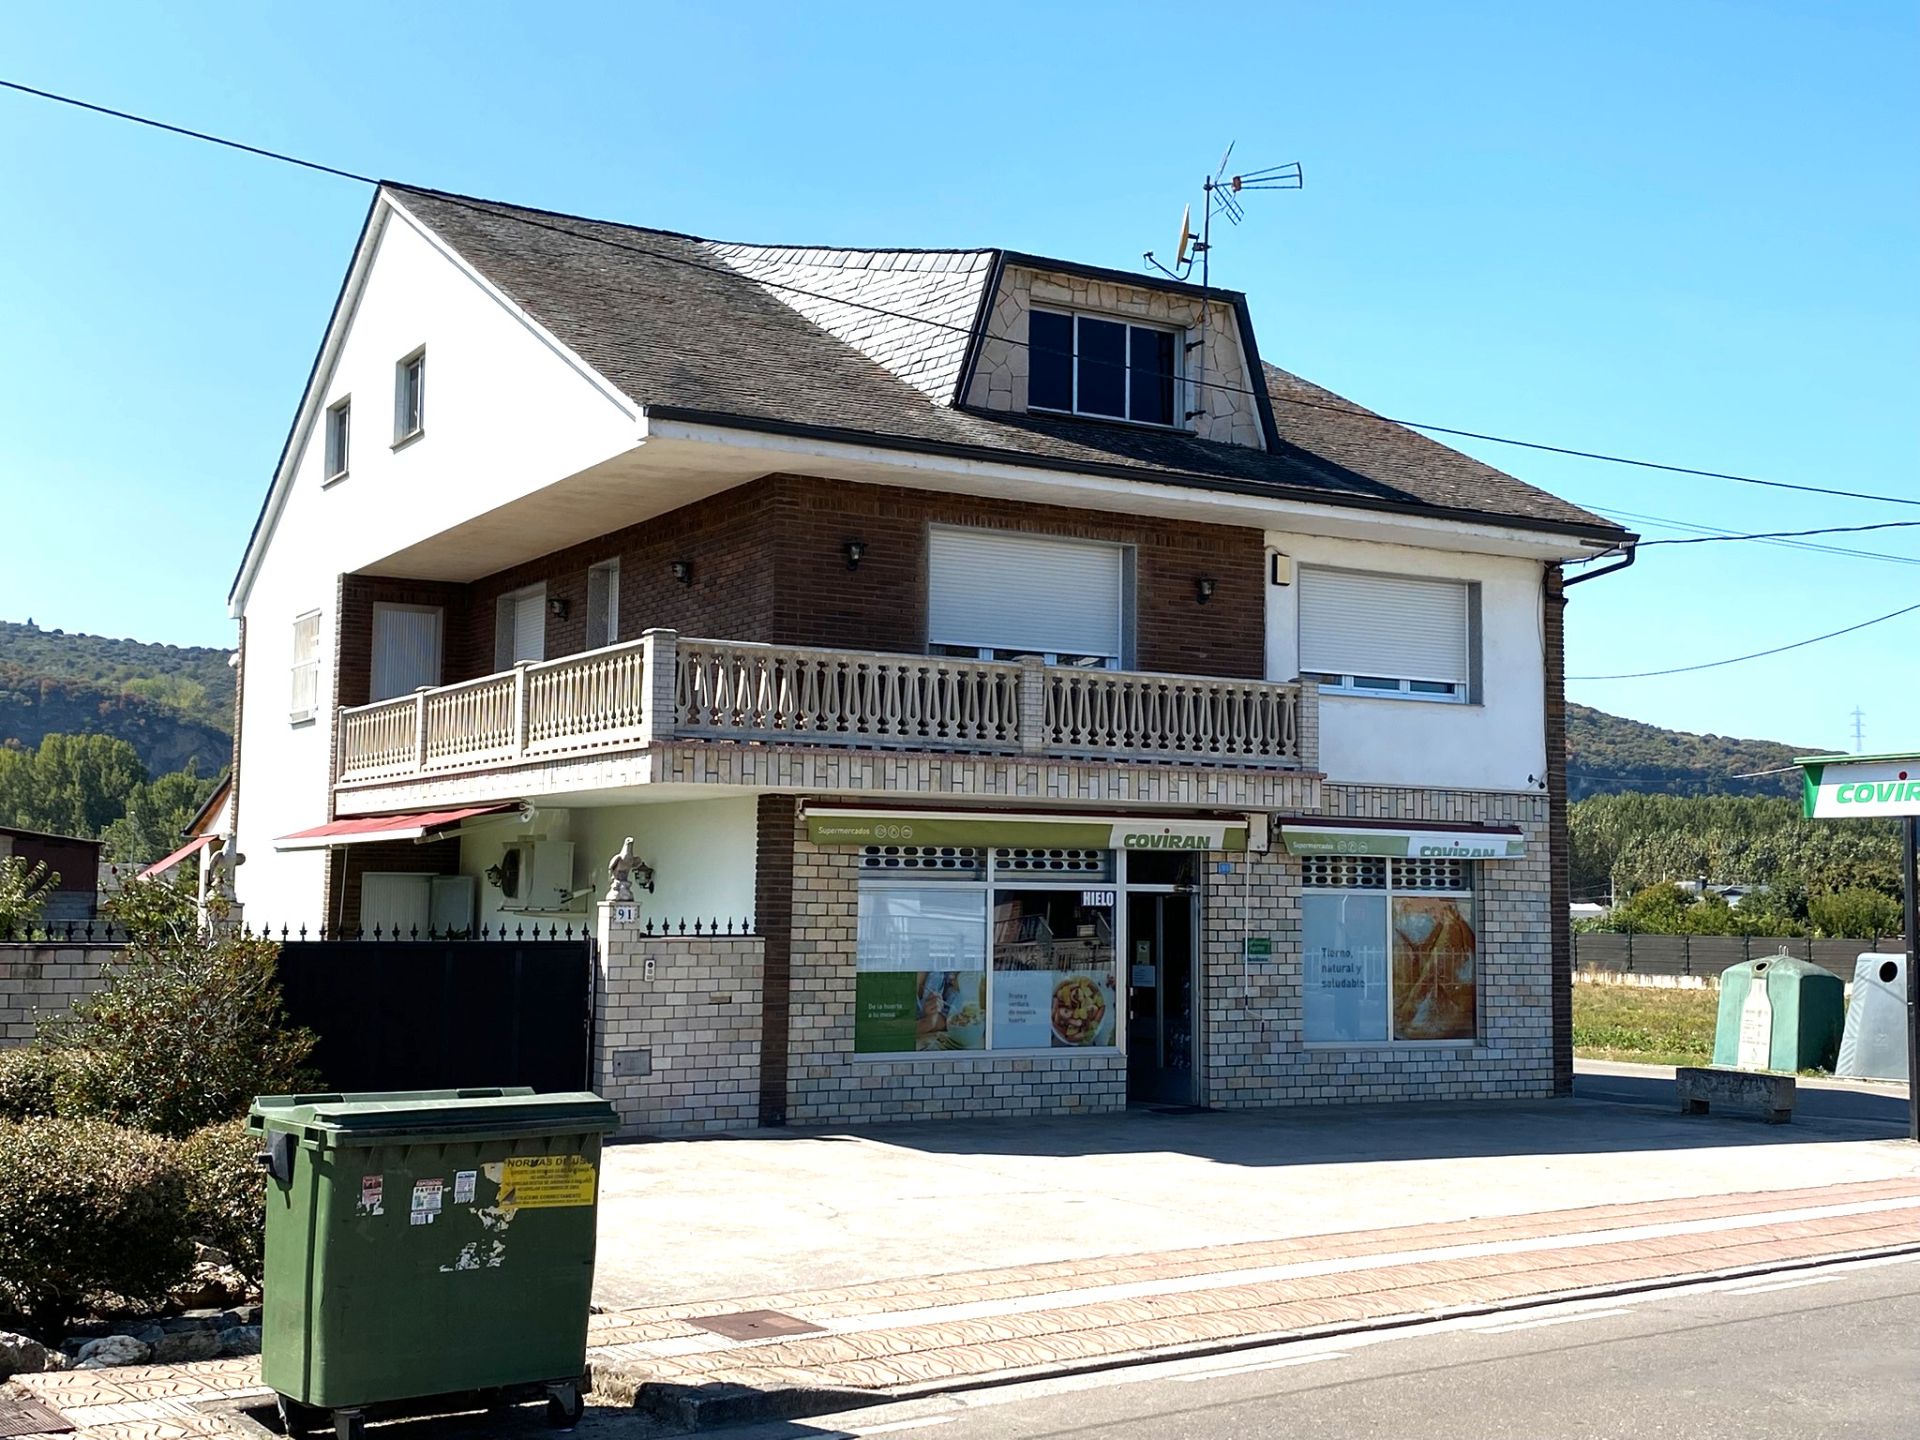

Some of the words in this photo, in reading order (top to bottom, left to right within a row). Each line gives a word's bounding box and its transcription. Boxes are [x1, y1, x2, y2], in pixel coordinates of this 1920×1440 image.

[818, 826, 870, 836] Supermercados
[1124, 828, 1211, 849] COVIRAN
[1083, 891, 1114, 907] HIELO
[618, 908, 632, 920] 91
[1321, 947, 1354, 960] Tierno,
[1321, 963, 1354, 973] natural
[1355, 965, 1362, 975] y
[1321, 978, 1366, 988] saludable
